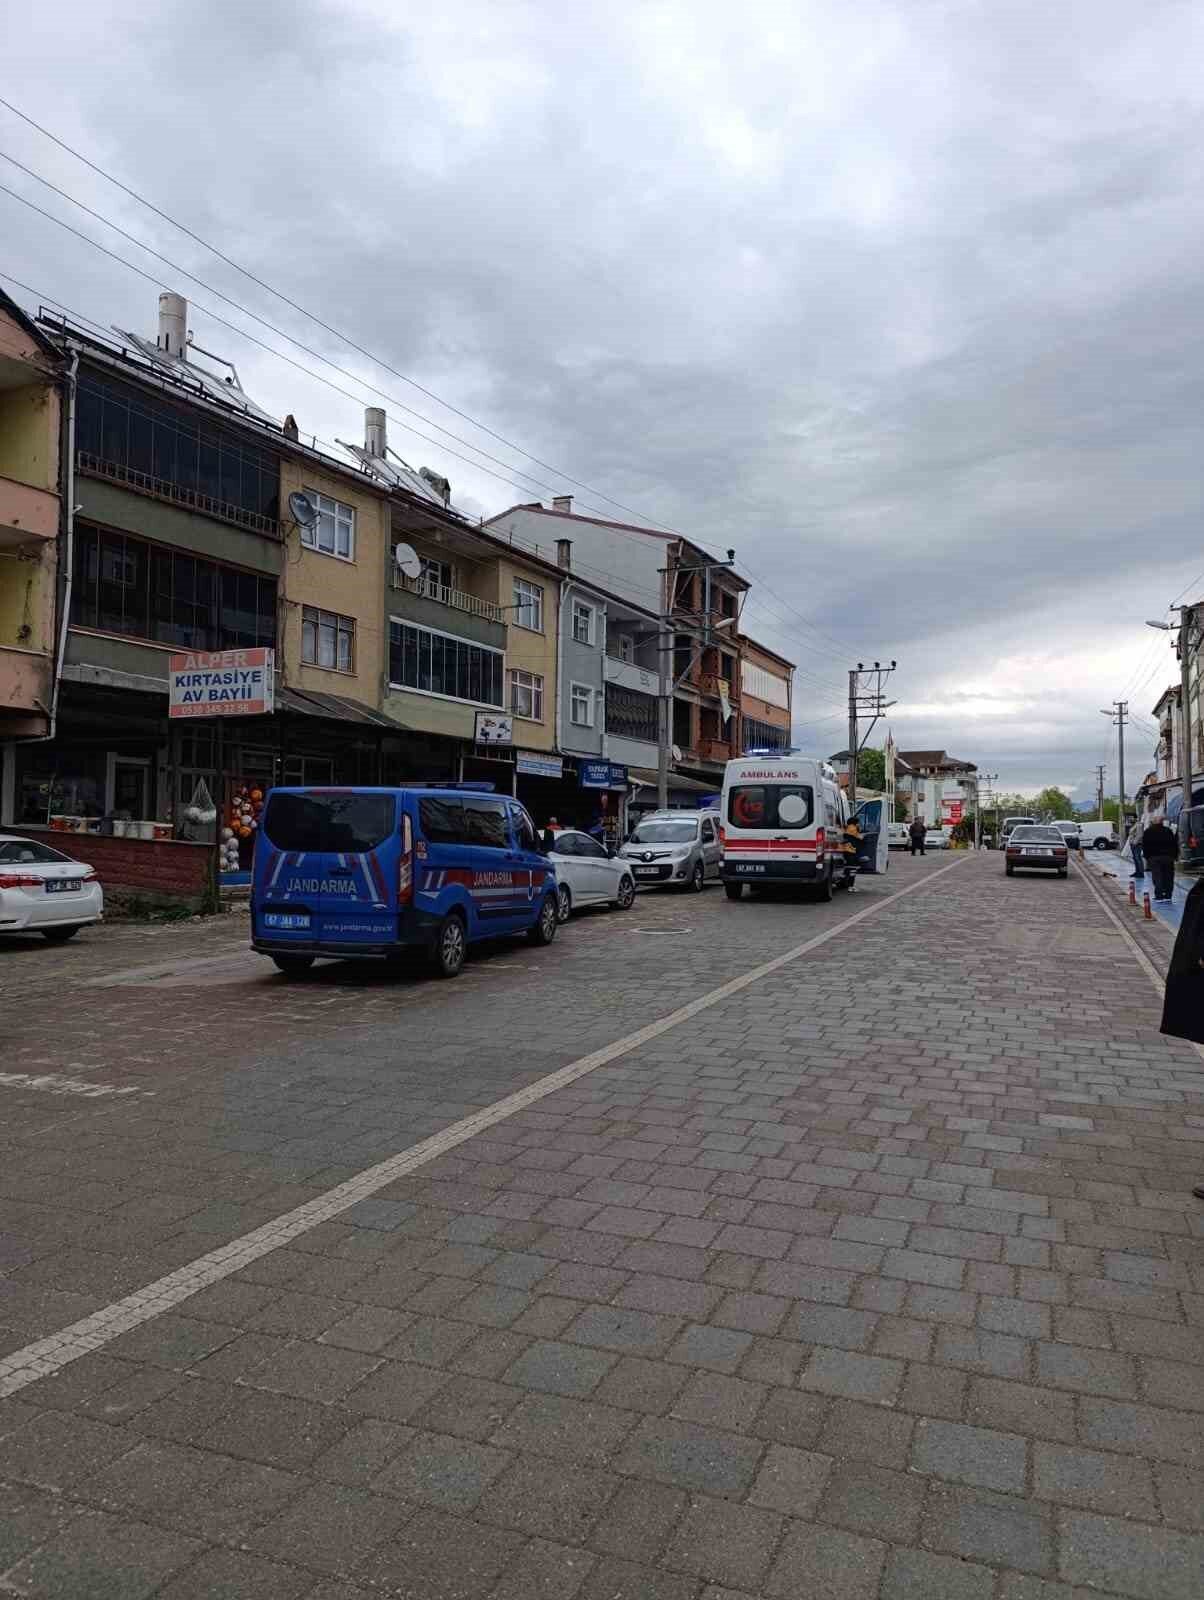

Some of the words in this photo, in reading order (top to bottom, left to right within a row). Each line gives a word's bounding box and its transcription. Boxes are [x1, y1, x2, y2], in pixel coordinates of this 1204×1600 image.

[184, 653, 247, 669] ALPER
[175, 669, 262, 687] KIRTASİYE
[182, 690, 203, 702] AV
[209, 684, 252, 701] BAYİİ
[740, 770, 799, 779] AMBULANS
[287, 878, 358, 894] JANDARMA
[472, 871, 513, 889] JANDARMA
